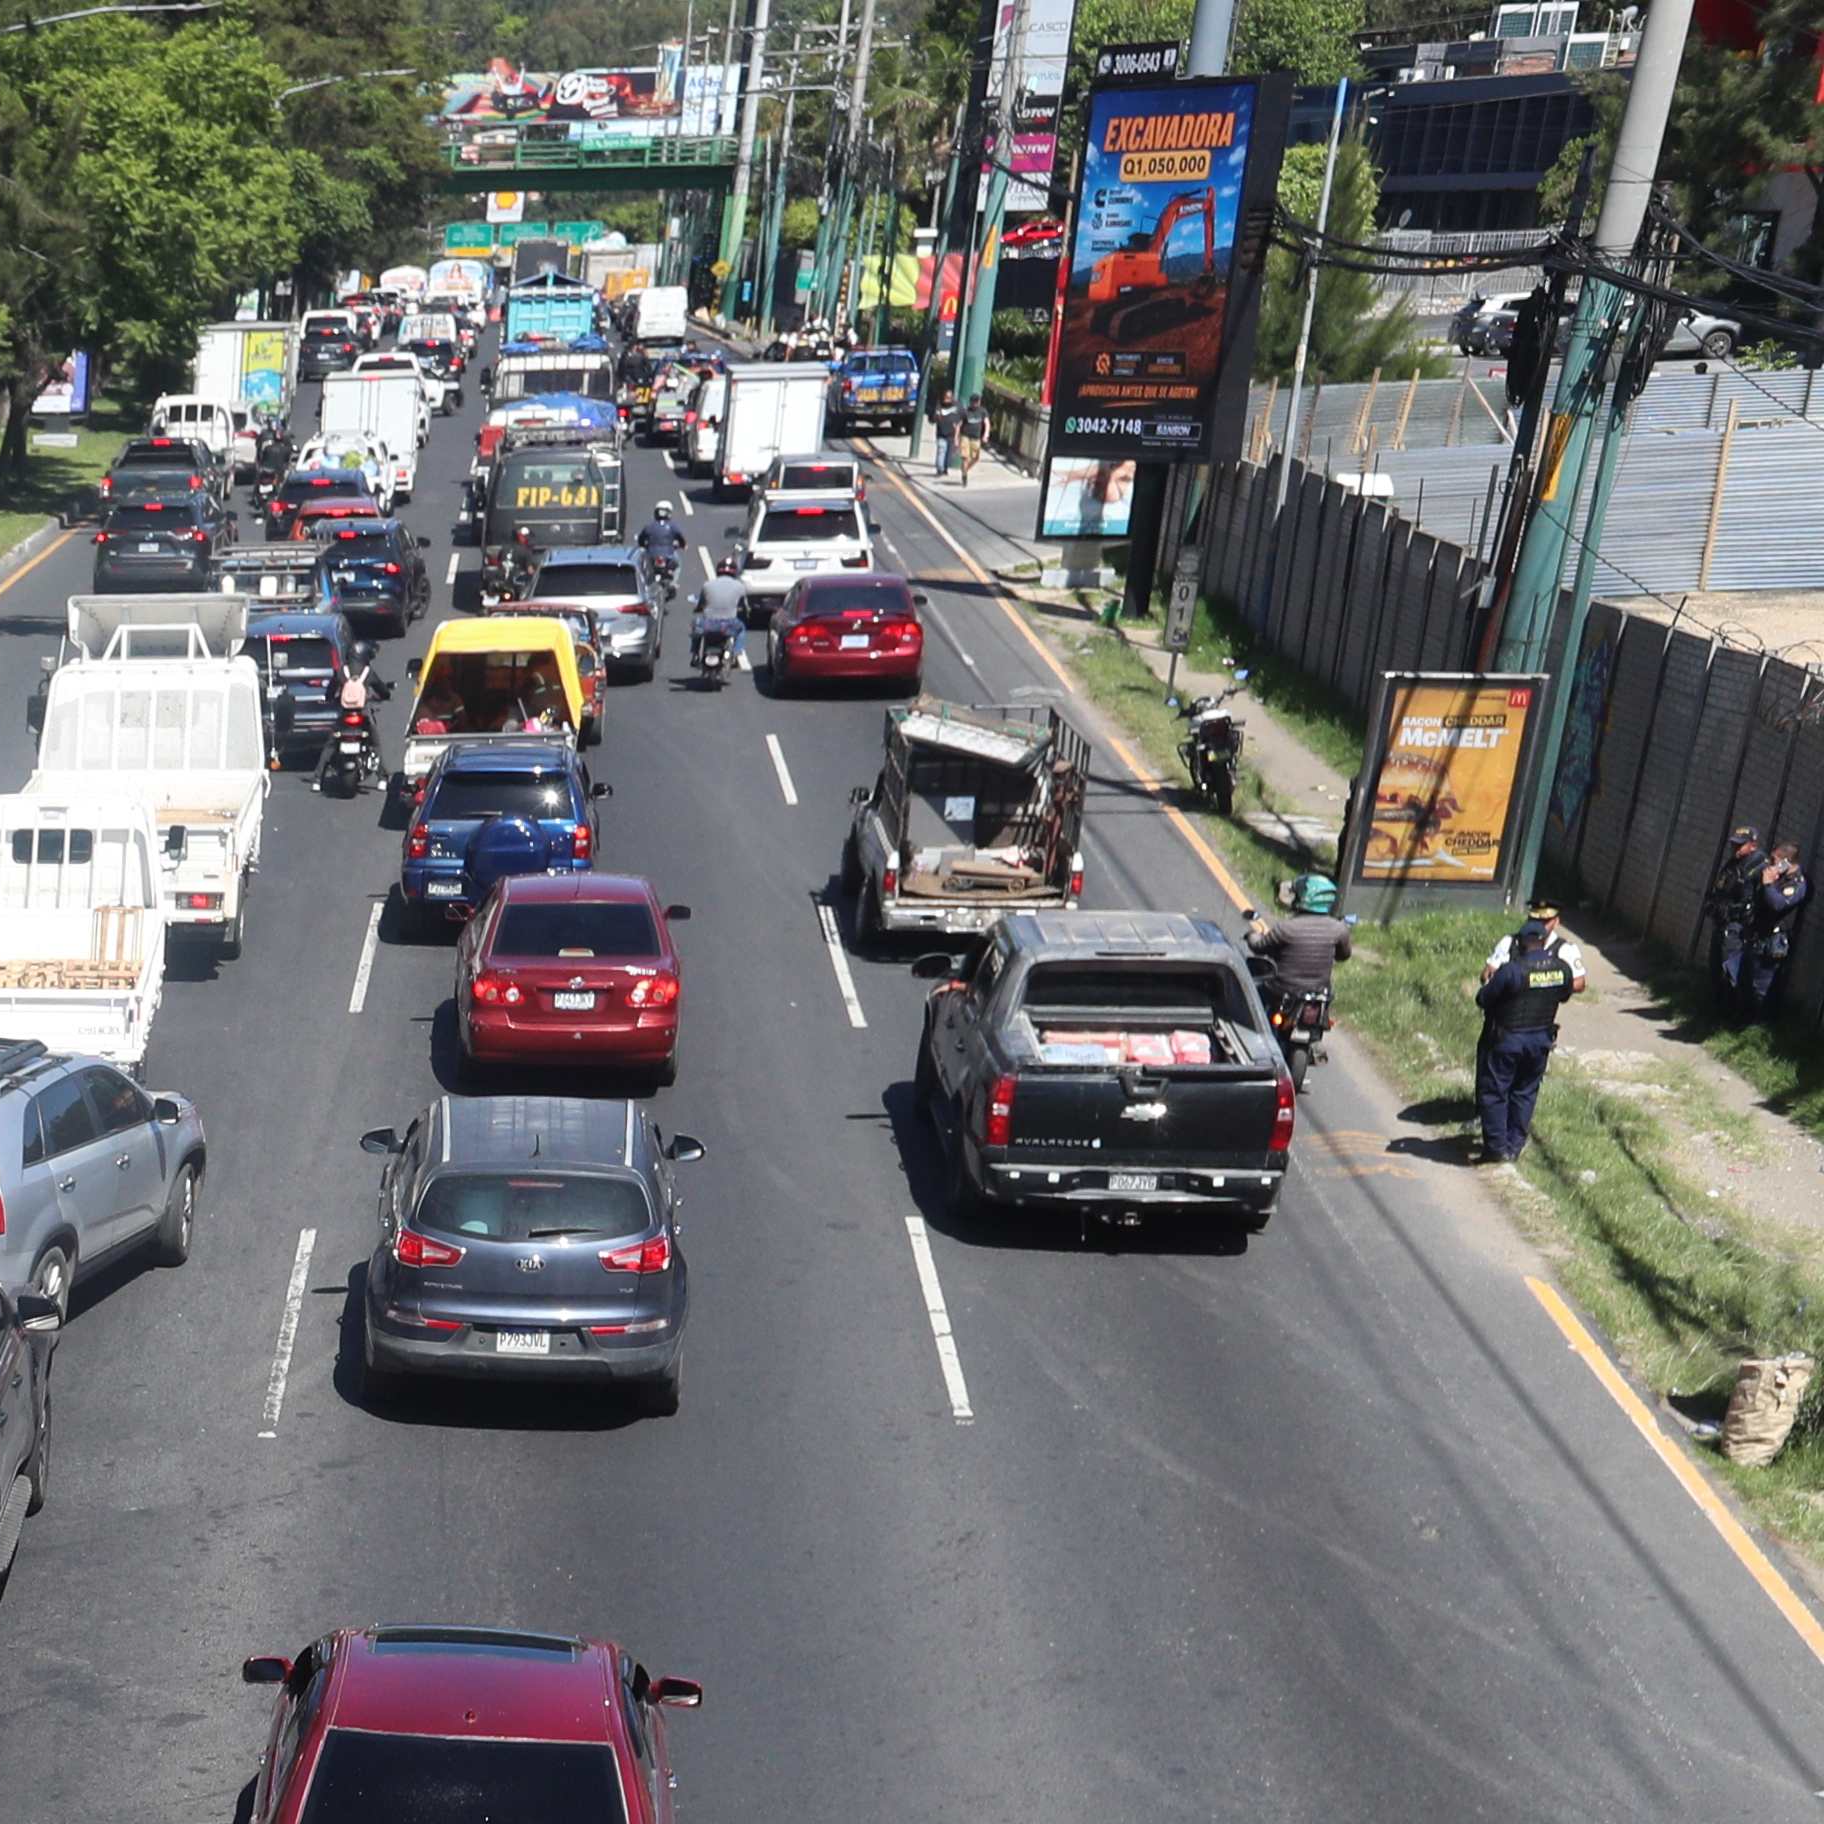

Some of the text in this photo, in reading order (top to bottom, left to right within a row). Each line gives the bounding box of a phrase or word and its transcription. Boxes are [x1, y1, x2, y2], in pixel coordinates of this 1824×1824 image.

[1113, 53, 1161, 75] 3006-0543
[1103, 112, 1236, 152] EXCAVADORA
[1123, 156, 1206, 177] Q1,050,000
[1077, 417, 1142, 435] 3042-7148
[1402, 716, 1442, 727] BACON
[520, 1258, 541, 1269] KIA
